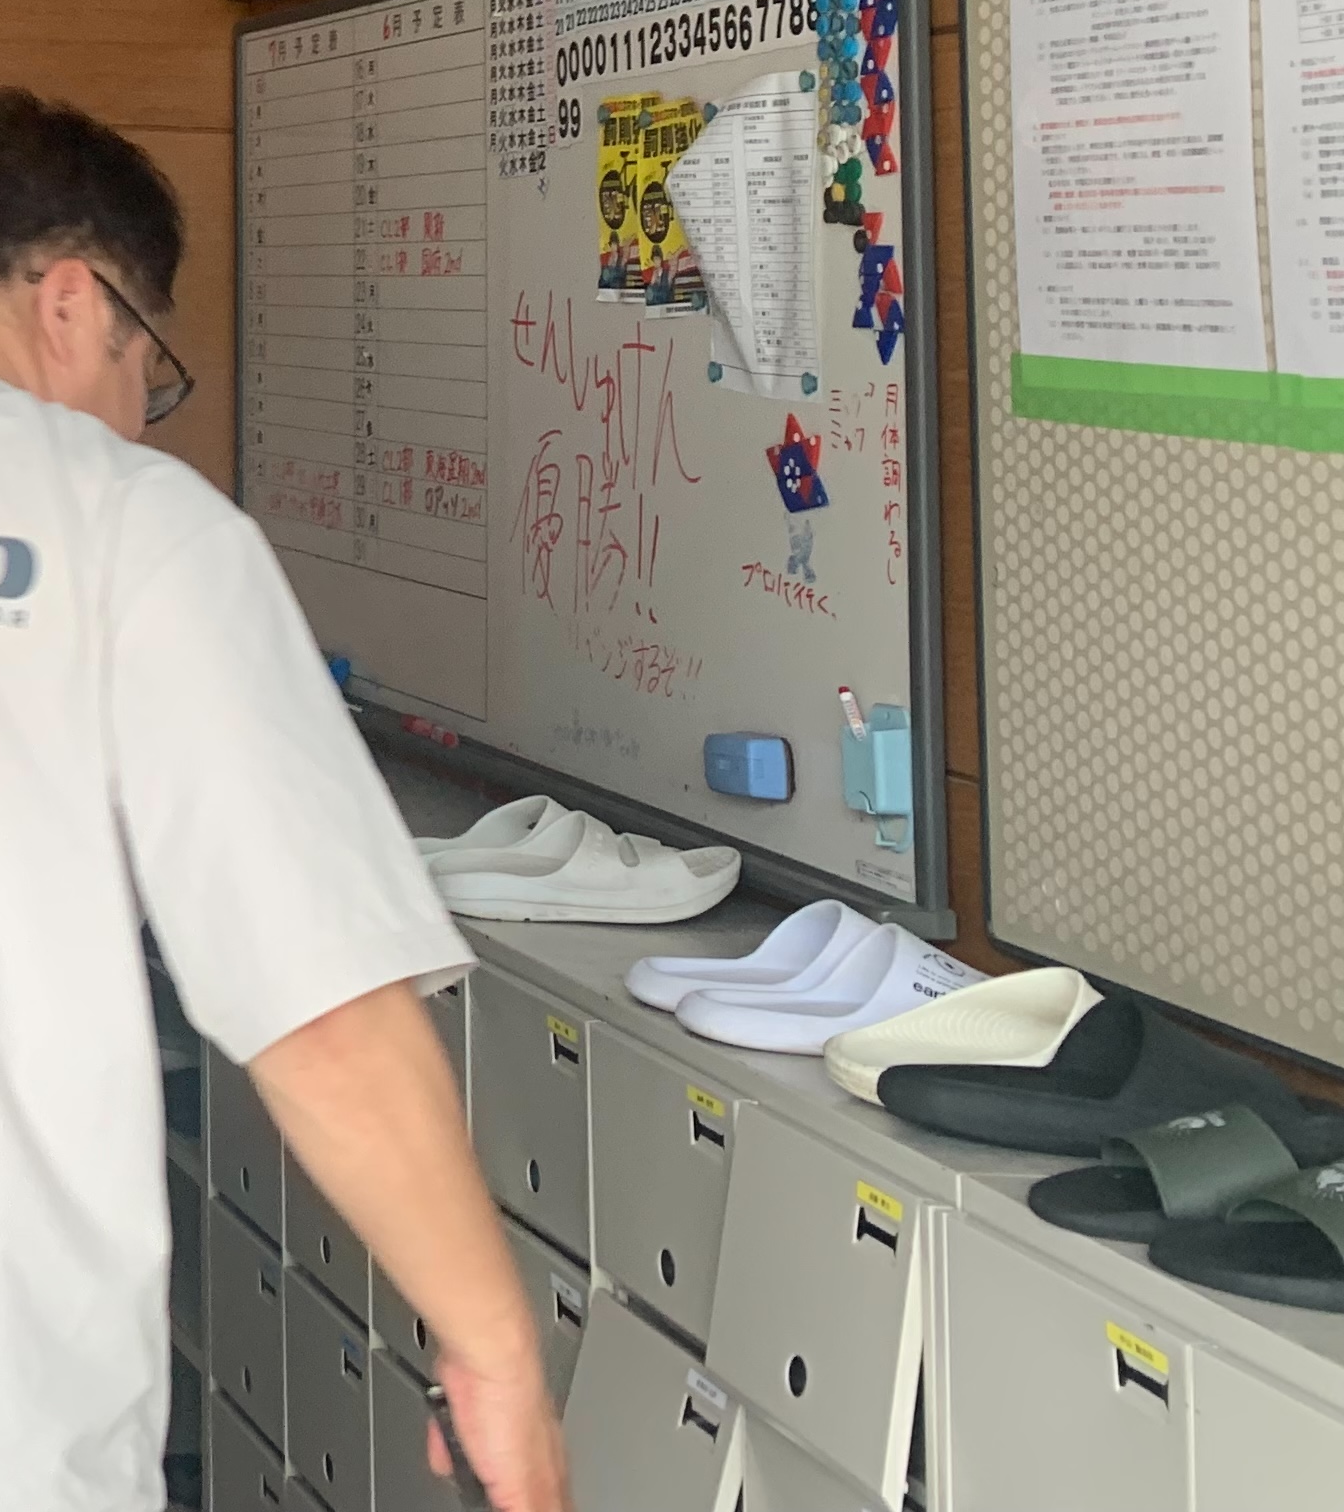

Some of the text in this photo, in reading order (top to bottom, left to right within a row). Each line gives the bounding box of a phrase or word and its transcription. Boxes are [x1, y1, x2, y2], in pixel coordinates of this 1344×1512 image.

[556, 18, 564, 36] 21
[566, 14, 574, 31] 21
[577, 8, 586, 26] 22
[588, 6, 597, 24] 22
[599, 4, 608, 22] 23
[610, 1, 620, 20] 23
[622, 0, 631, 18] 24
[558, 99, 581, 138] 99
